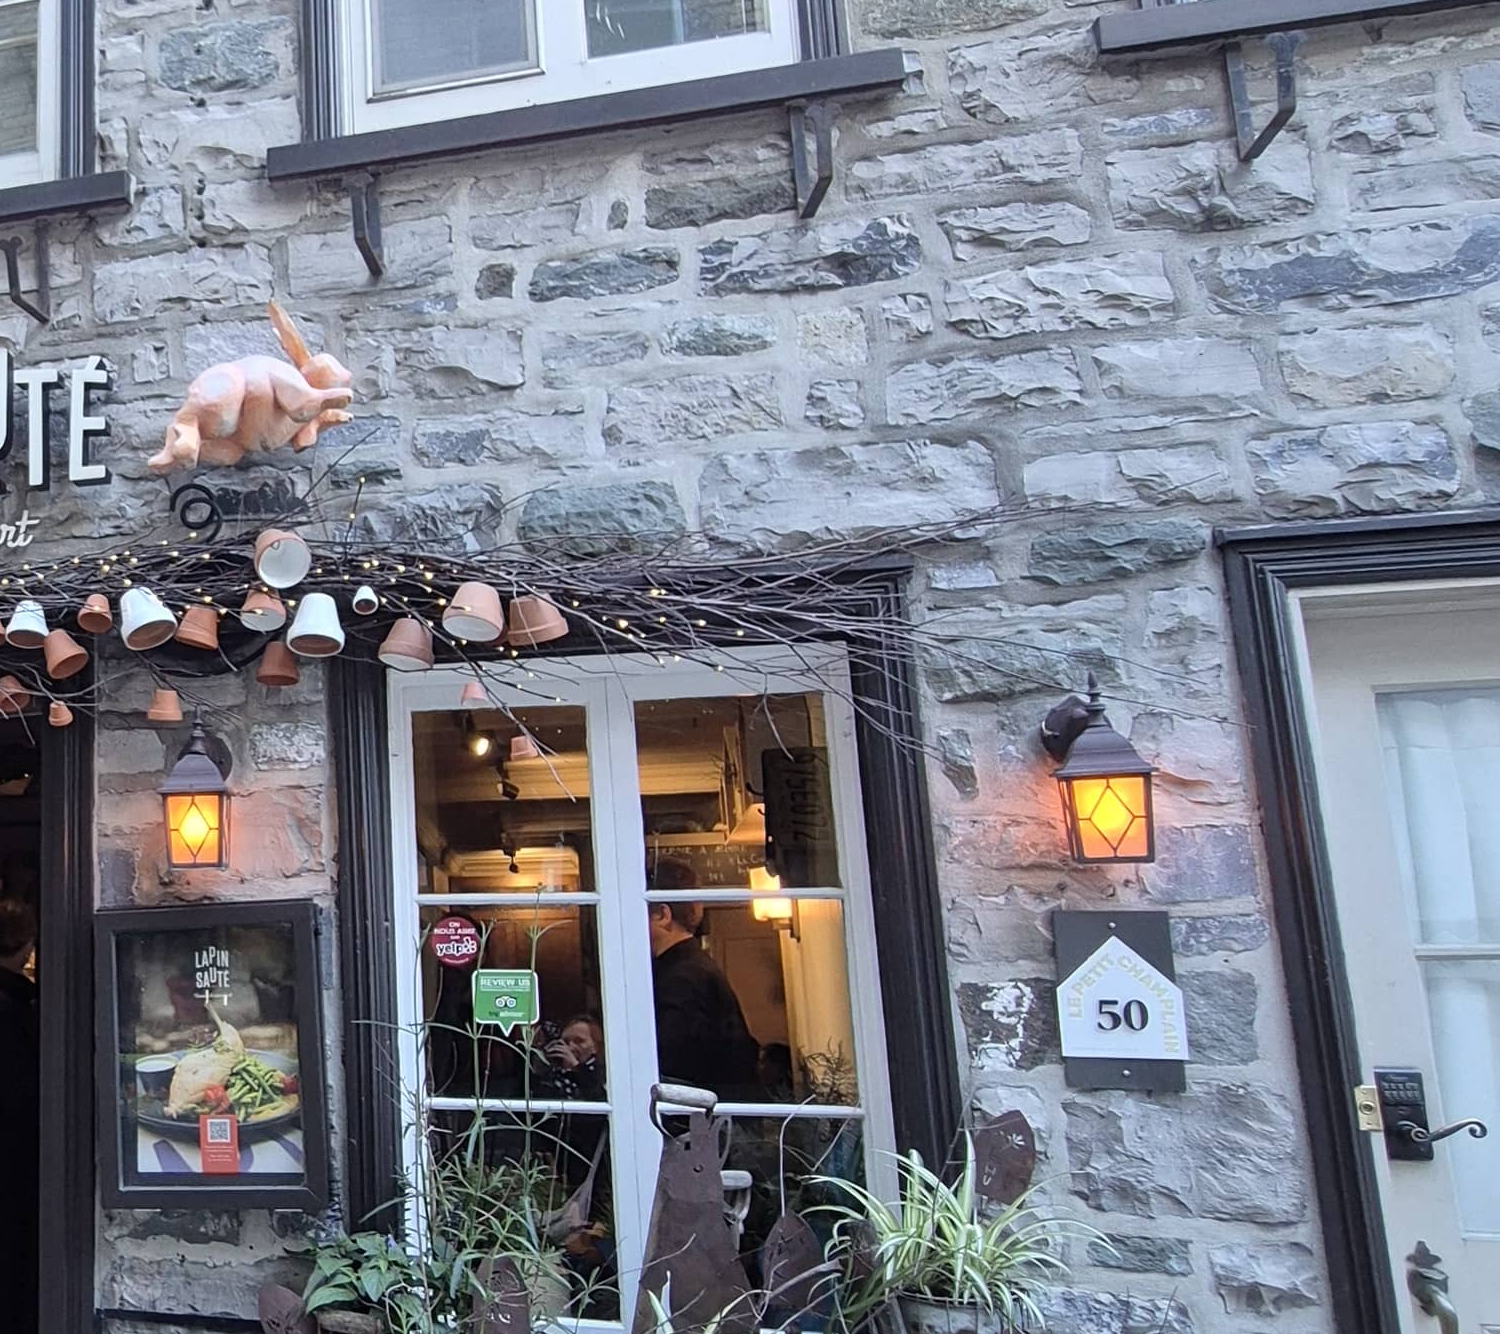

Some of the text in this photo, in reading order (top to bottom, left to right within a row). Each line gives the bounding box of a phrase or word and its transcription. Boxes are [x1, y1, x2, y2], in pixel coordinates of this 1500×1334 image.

[195, 946, 229, 968] LAPIN
[437, 941, 464, 956] yelp
[480, 978, 515, 987] REVIEW
[1097, 999, 1149, 1031] 50
